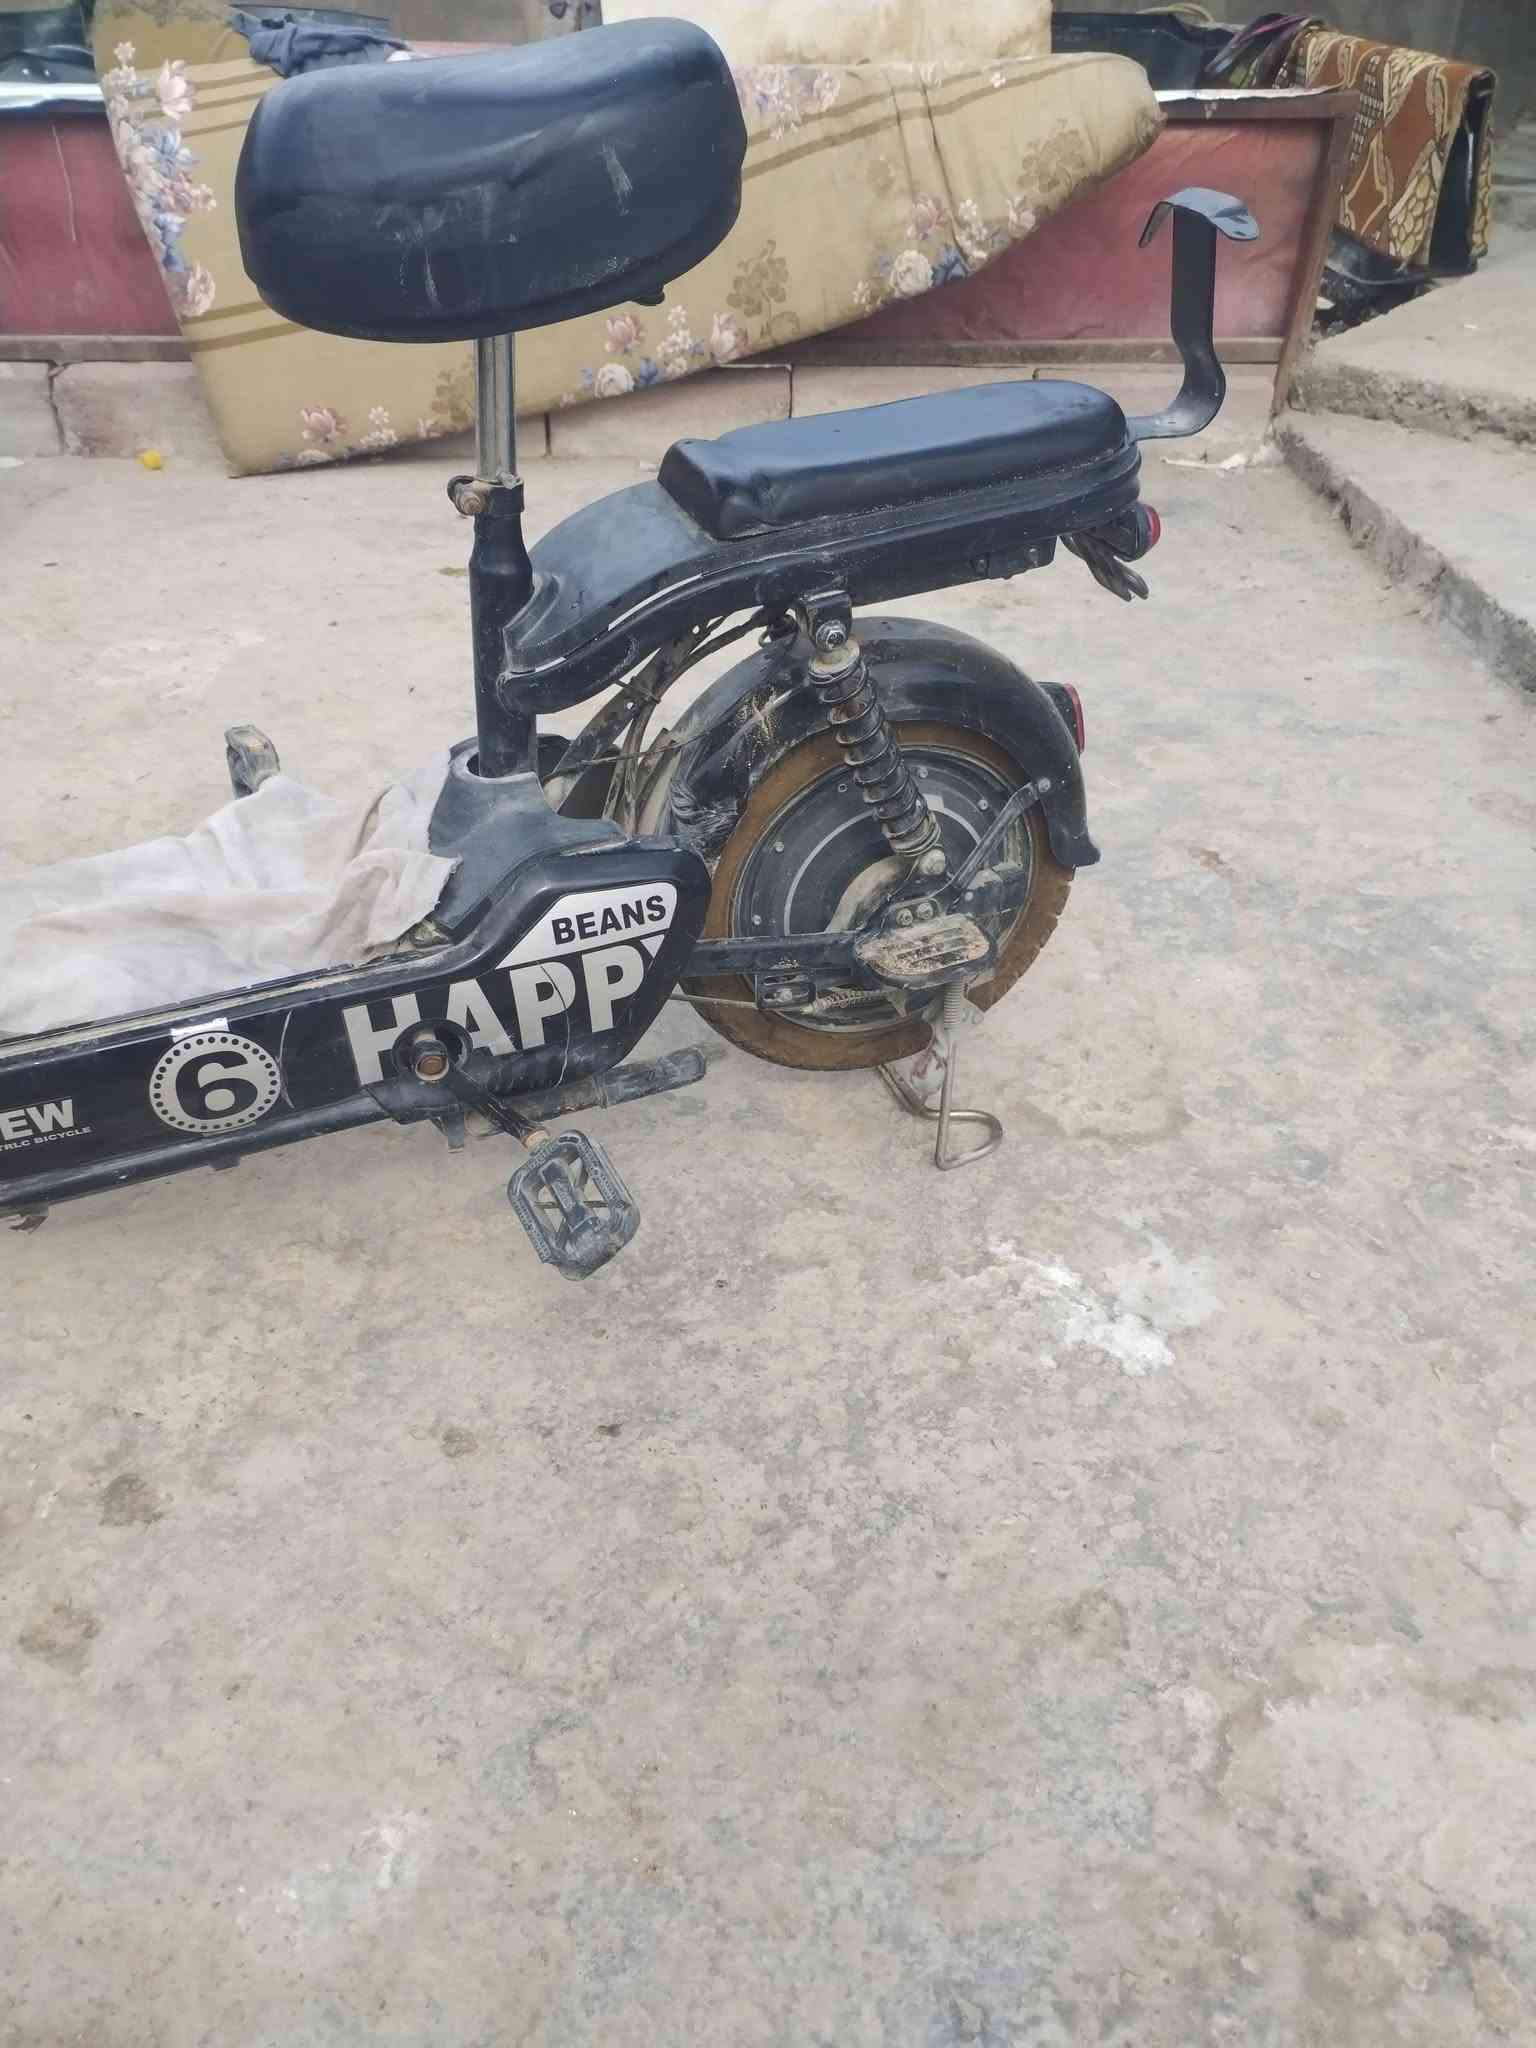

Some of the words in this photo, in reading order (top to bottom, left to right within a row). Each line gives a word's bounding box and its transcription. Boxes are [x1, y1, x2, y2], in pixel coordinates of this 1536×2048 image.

[552, 895, 666, 945] BEANS
[343, 934, 665, 1086] HAPP
[175, 1050, 258, 1120] 6
[33, 1126, 91, 1143] BICYCLE
